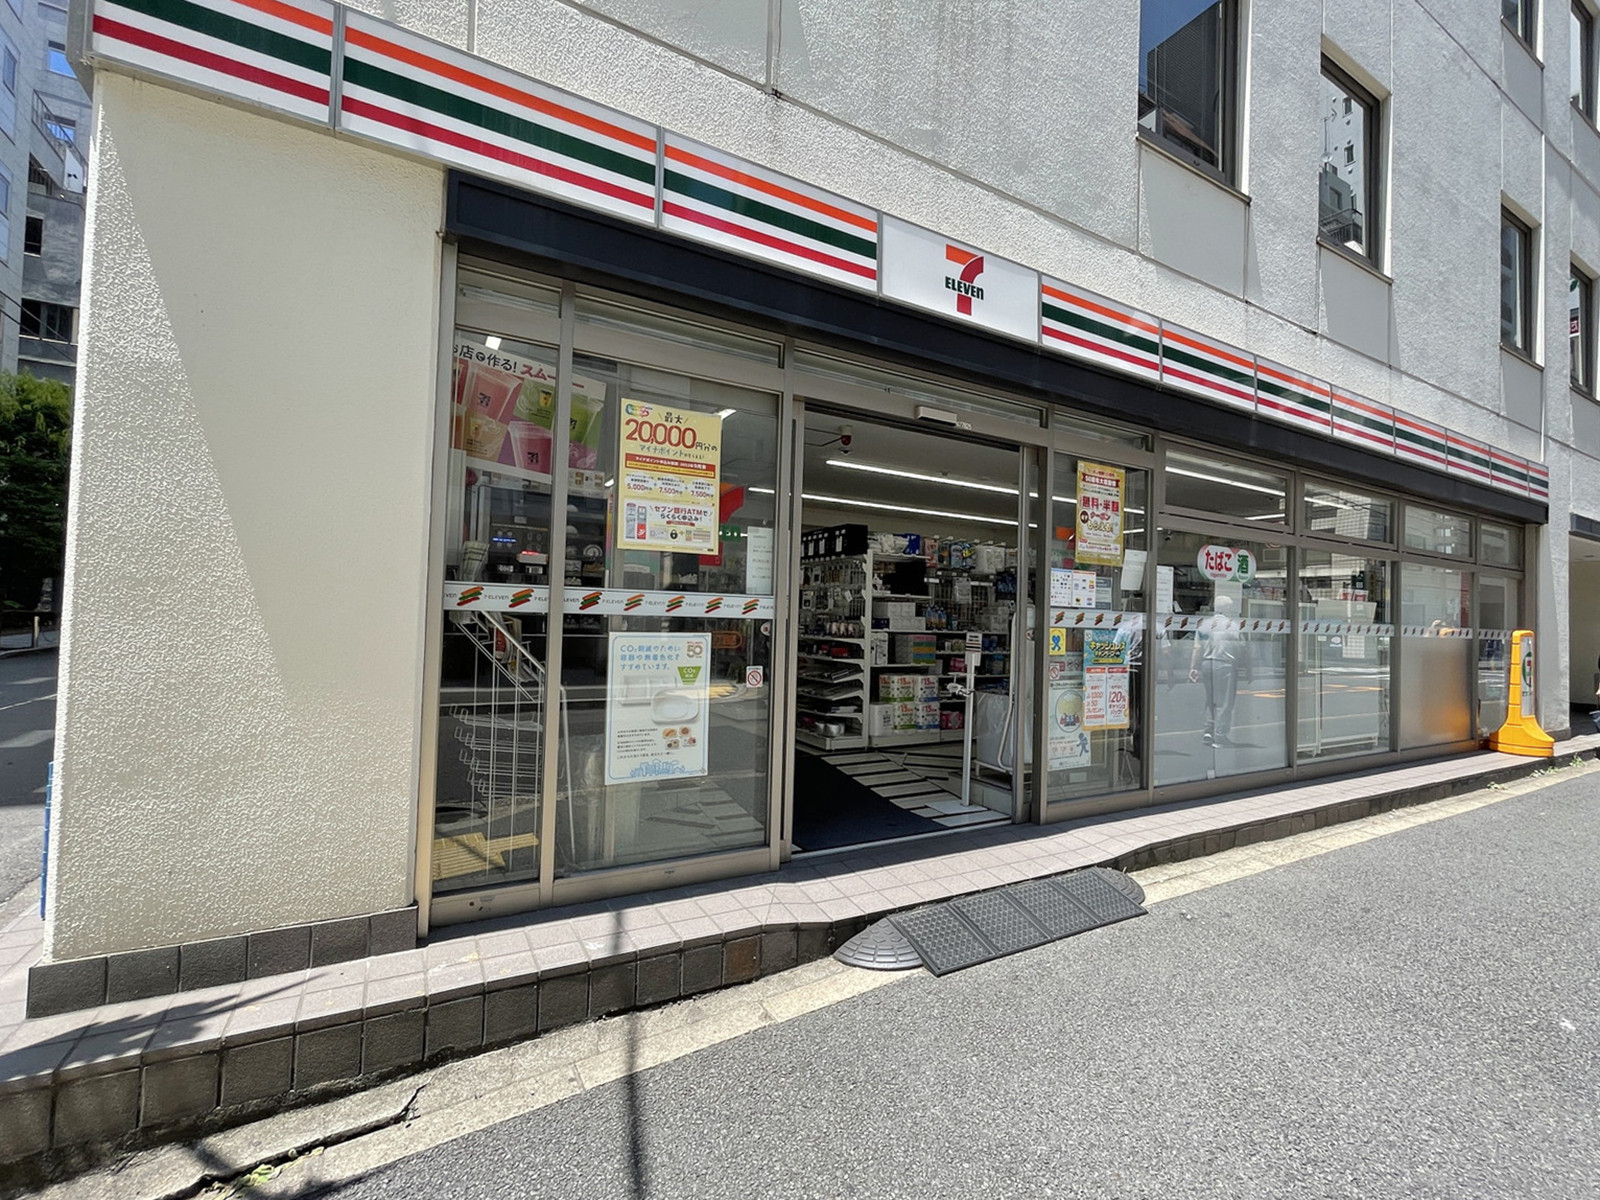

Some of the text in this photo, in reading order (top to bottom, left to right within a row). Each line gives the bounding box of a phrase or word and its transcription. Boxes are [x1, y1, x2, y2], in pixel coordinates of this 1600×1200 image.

[945, 243, 984, 316] 7
[664, 412, 683, 424] 最大
[1205, 550, 1232, 571] たばこ
[1237, 554, 1249, 574] 酒
